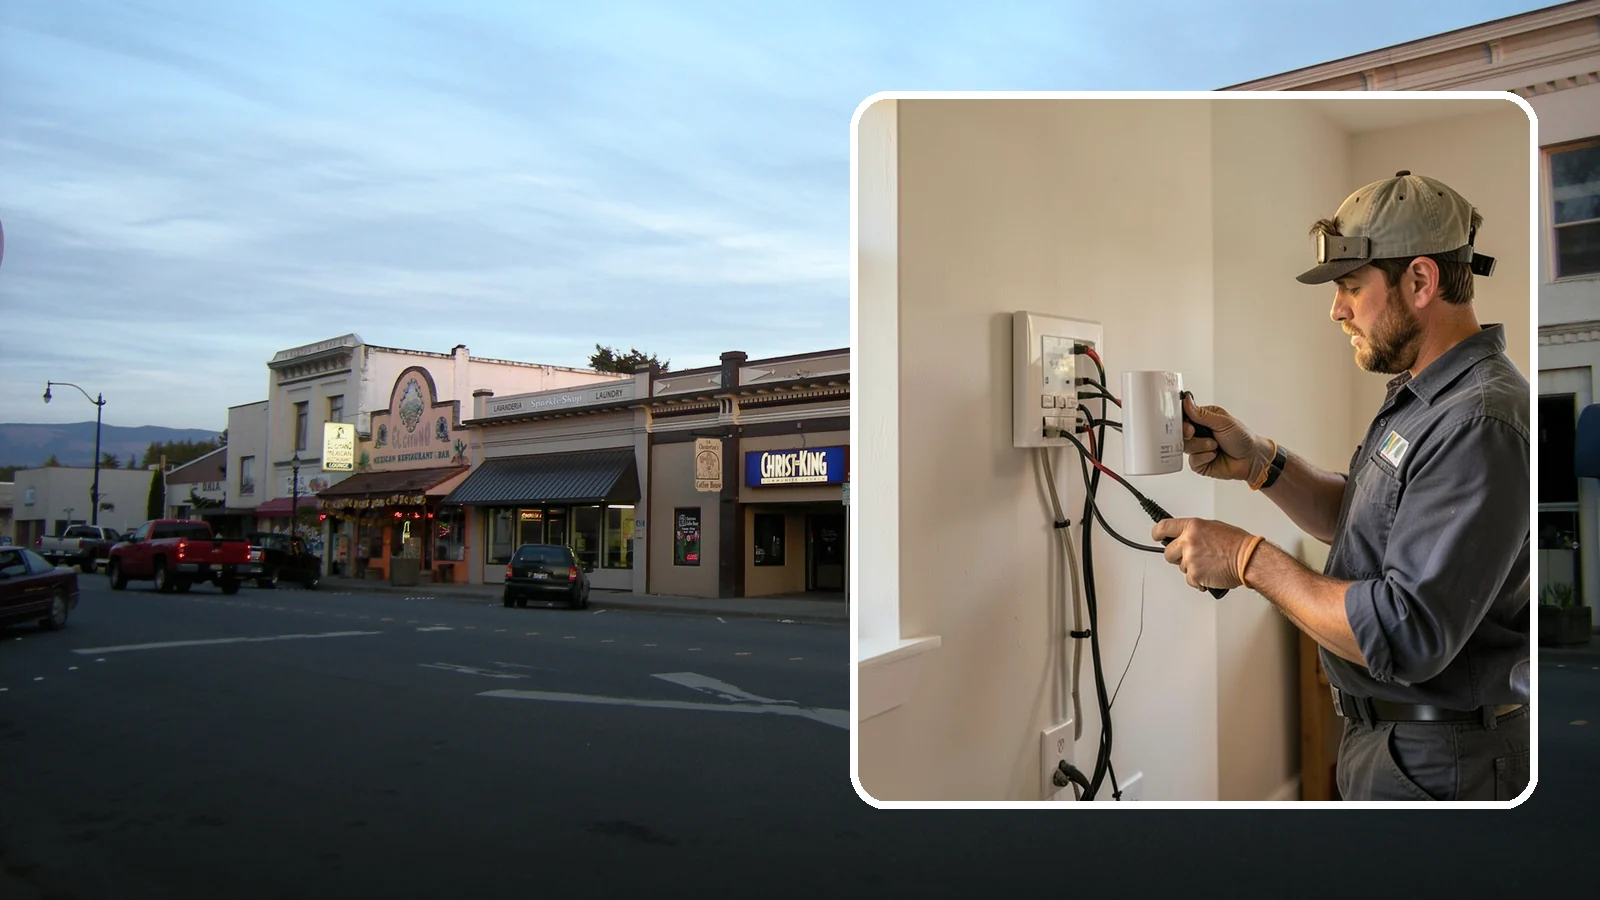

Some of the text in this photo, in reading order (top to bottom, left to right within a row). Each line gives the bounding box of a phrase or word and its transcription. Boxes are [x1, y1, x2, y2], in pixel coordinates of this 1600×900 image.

[596, 389, 623, 400] LAUNDRY
[493, 402, 522, 412] LAVANDERIA
[531, 395, 582, 409] Sparkle Shop
[374, 450, 450, 464] MEXICAN RESTAURANT BAR
[761, 450, 828, 477] CHRIST KING
[696, 480, 722, 489] Coffee House
